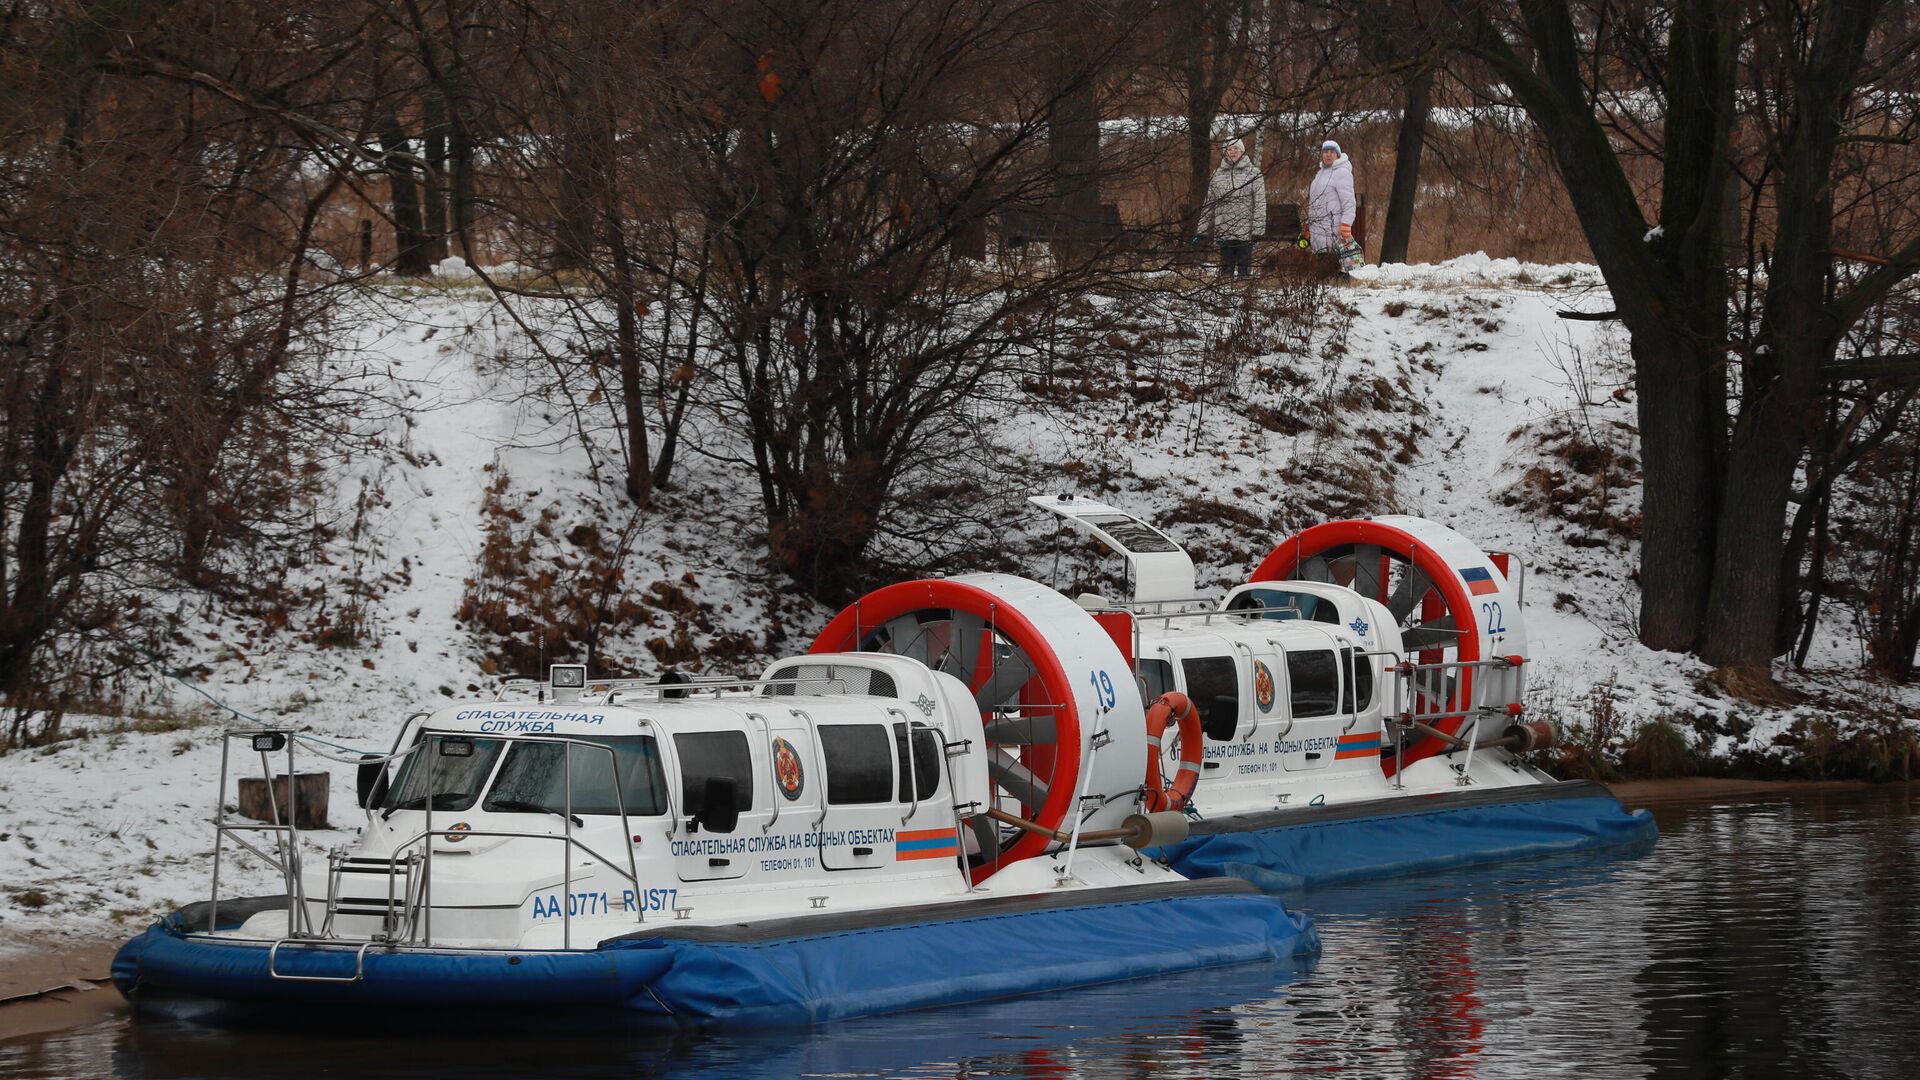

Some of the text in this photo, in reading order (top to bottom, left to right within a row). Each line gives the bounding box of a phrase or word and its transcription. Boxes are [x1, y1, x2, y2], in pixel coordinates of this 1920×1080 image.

[1482, 601, 1506, 635] 22
[1090, 669, 1116, 708] 19
[456, 710, 604, 725] СПАСАТЕЛЬНАЯ
[480, 721, 555, 733] СЛУЖБА
[1227, 743, 1255, 758] СЛУЖБА
[1258, 743, 1268, 755] НА
[1274, 739, 1304, 754] ВОДНЫХ
[1304, 736, 1338, 752] ОБЪЕКТАХ
[1238, 764, 1261, 775] ТЕЛЕФОН
[1269, 762, 1278, 772] 101
[671, 828, 895, 857] СПАСАТЕЛЬНАЯ СЛУЖБА НА ВОДНЫХ ОБЪЕКТАХ
[761, 857, 815, 872] ТЕЛЕФОН 01, 101
[533, 889, 677, 919] AA 0771 RUS77
